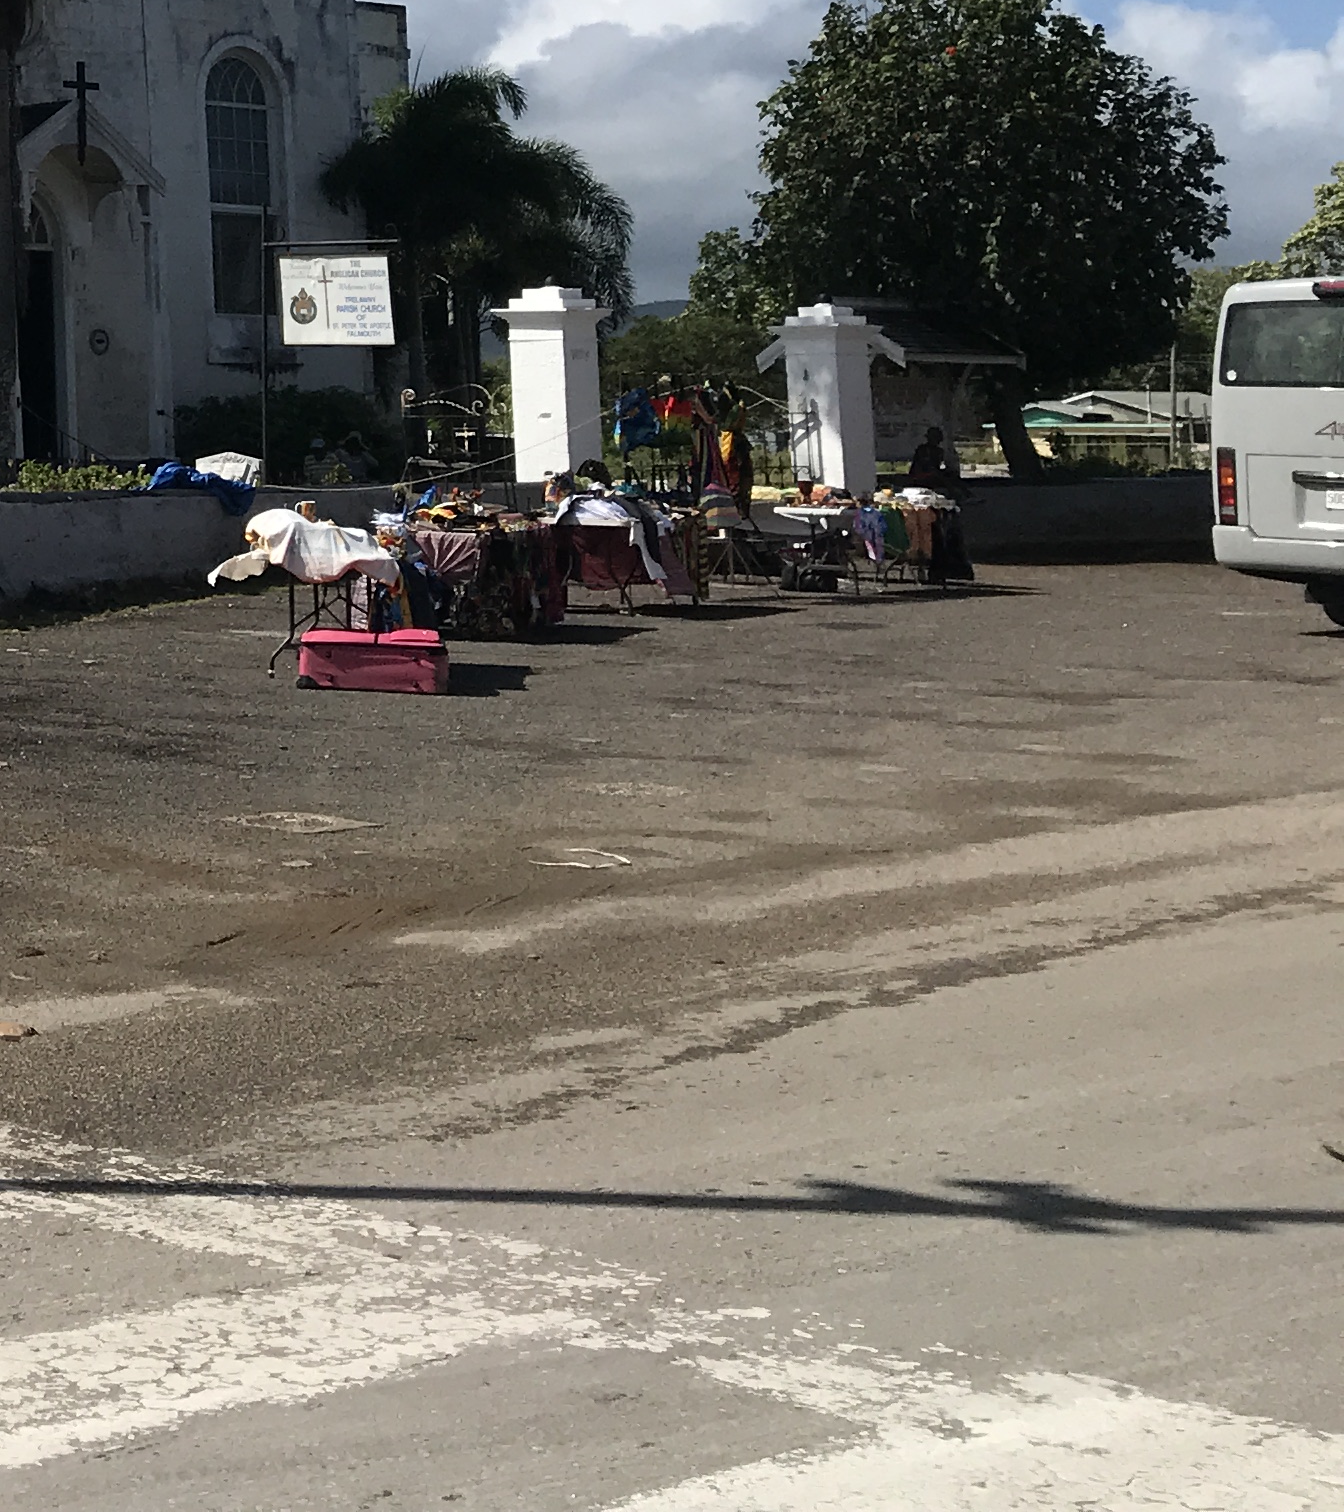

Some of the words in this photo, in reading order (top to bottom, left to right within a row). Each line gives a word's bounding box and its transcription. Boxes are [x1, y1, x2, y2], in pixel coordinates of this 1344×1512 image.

[330, 270, 359, 278] ANGLICAN
[361, 269, 386, 277] CHURCH
[336, 305, 358, 313] PARISH
[360, 304, 386, 313] CHURCH
